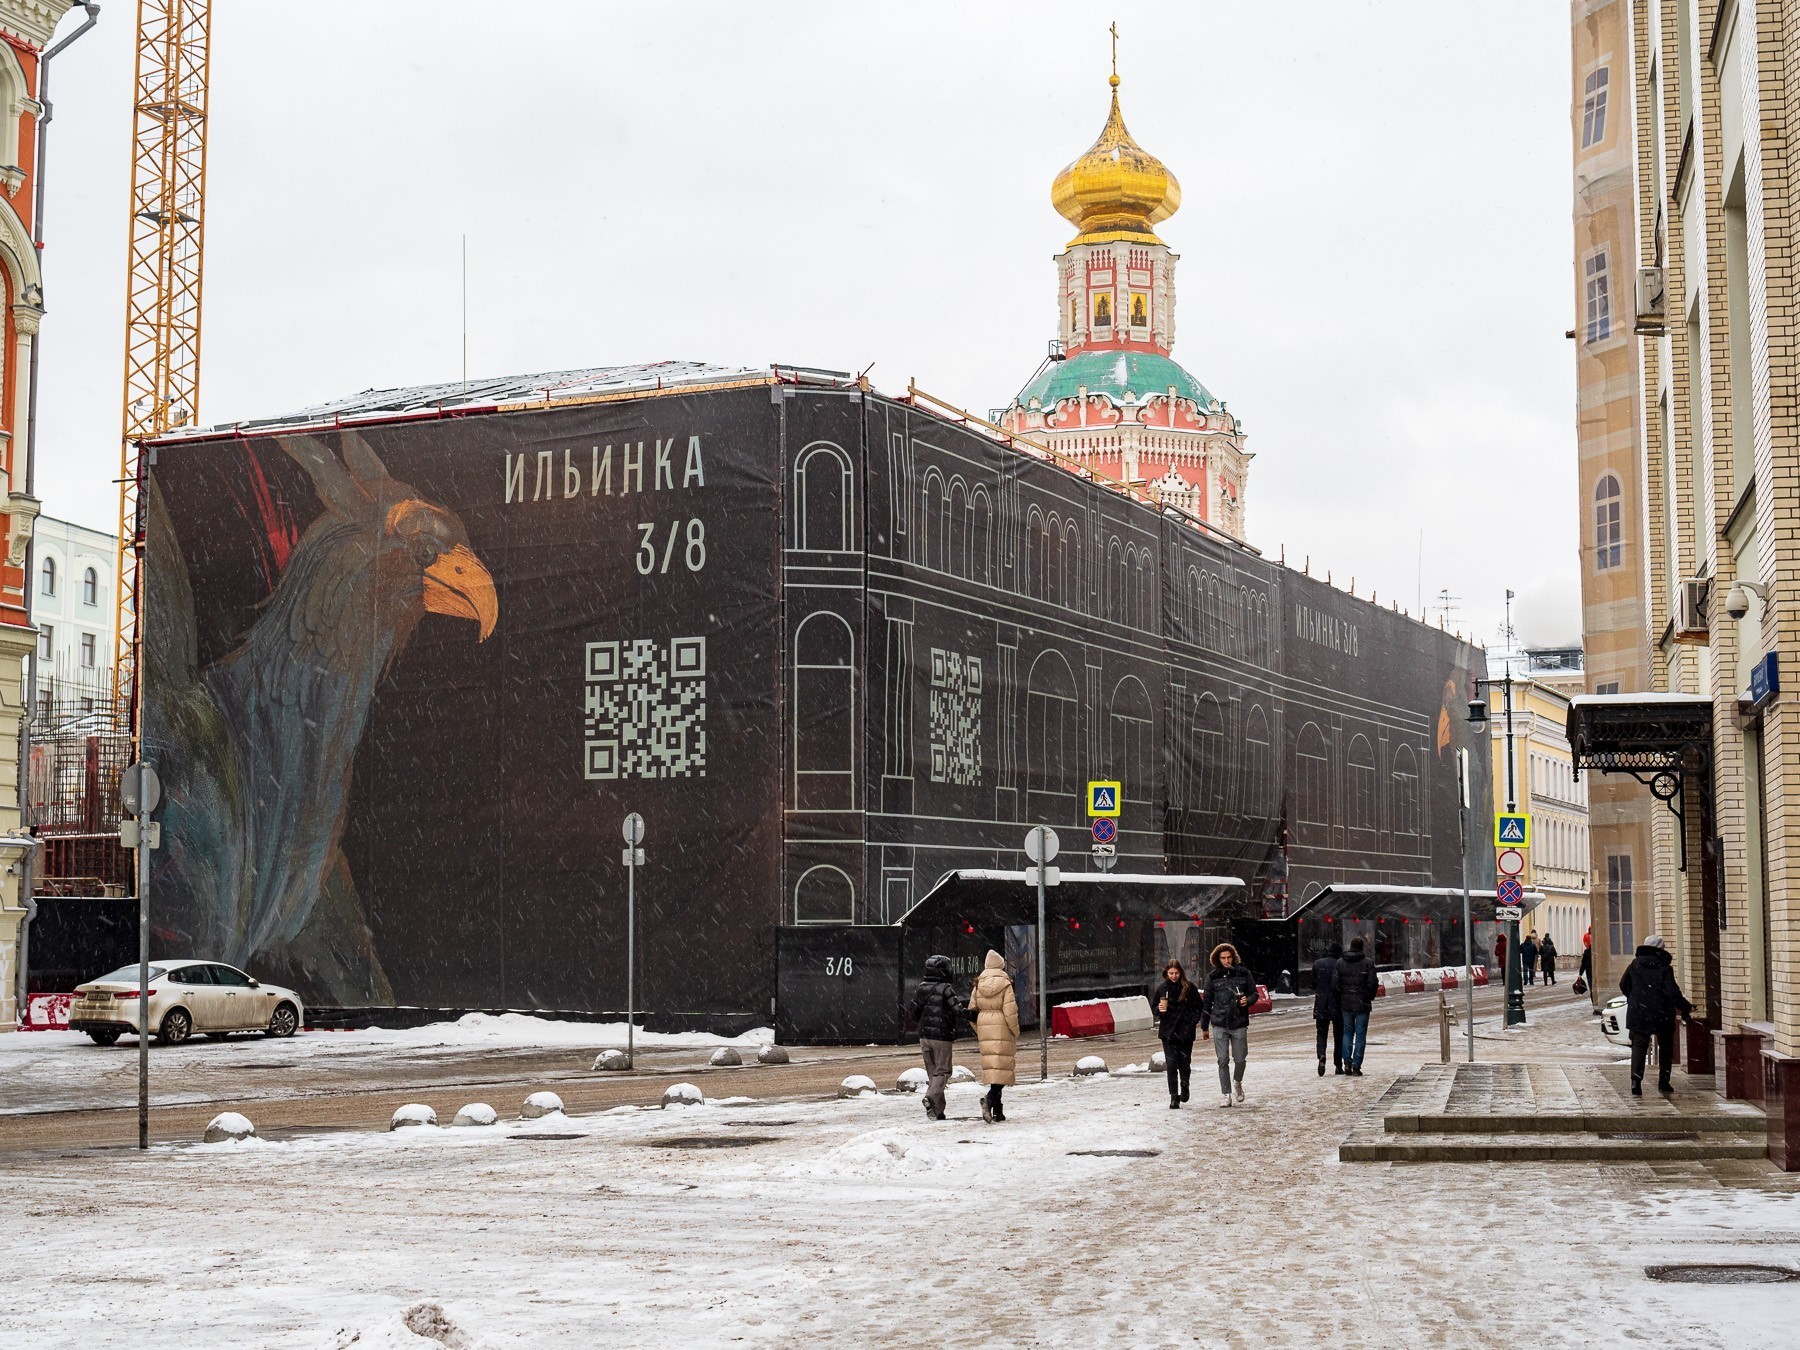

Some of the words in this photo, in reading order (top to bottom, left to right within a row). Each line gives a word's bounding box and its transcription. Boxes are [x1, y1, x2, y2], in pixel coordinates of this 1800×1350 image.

[504, 435, 705, 504] ИЛЬИНКА
[635, 518, 707, 575] 3/8
[1295, 603, 1341, 651] ИЛЬИНКА
[1343, 622, 1359, 658] 3/8
[826, 956, 853, 976] 3/8
[967, 955, 979, 974] 3/8
